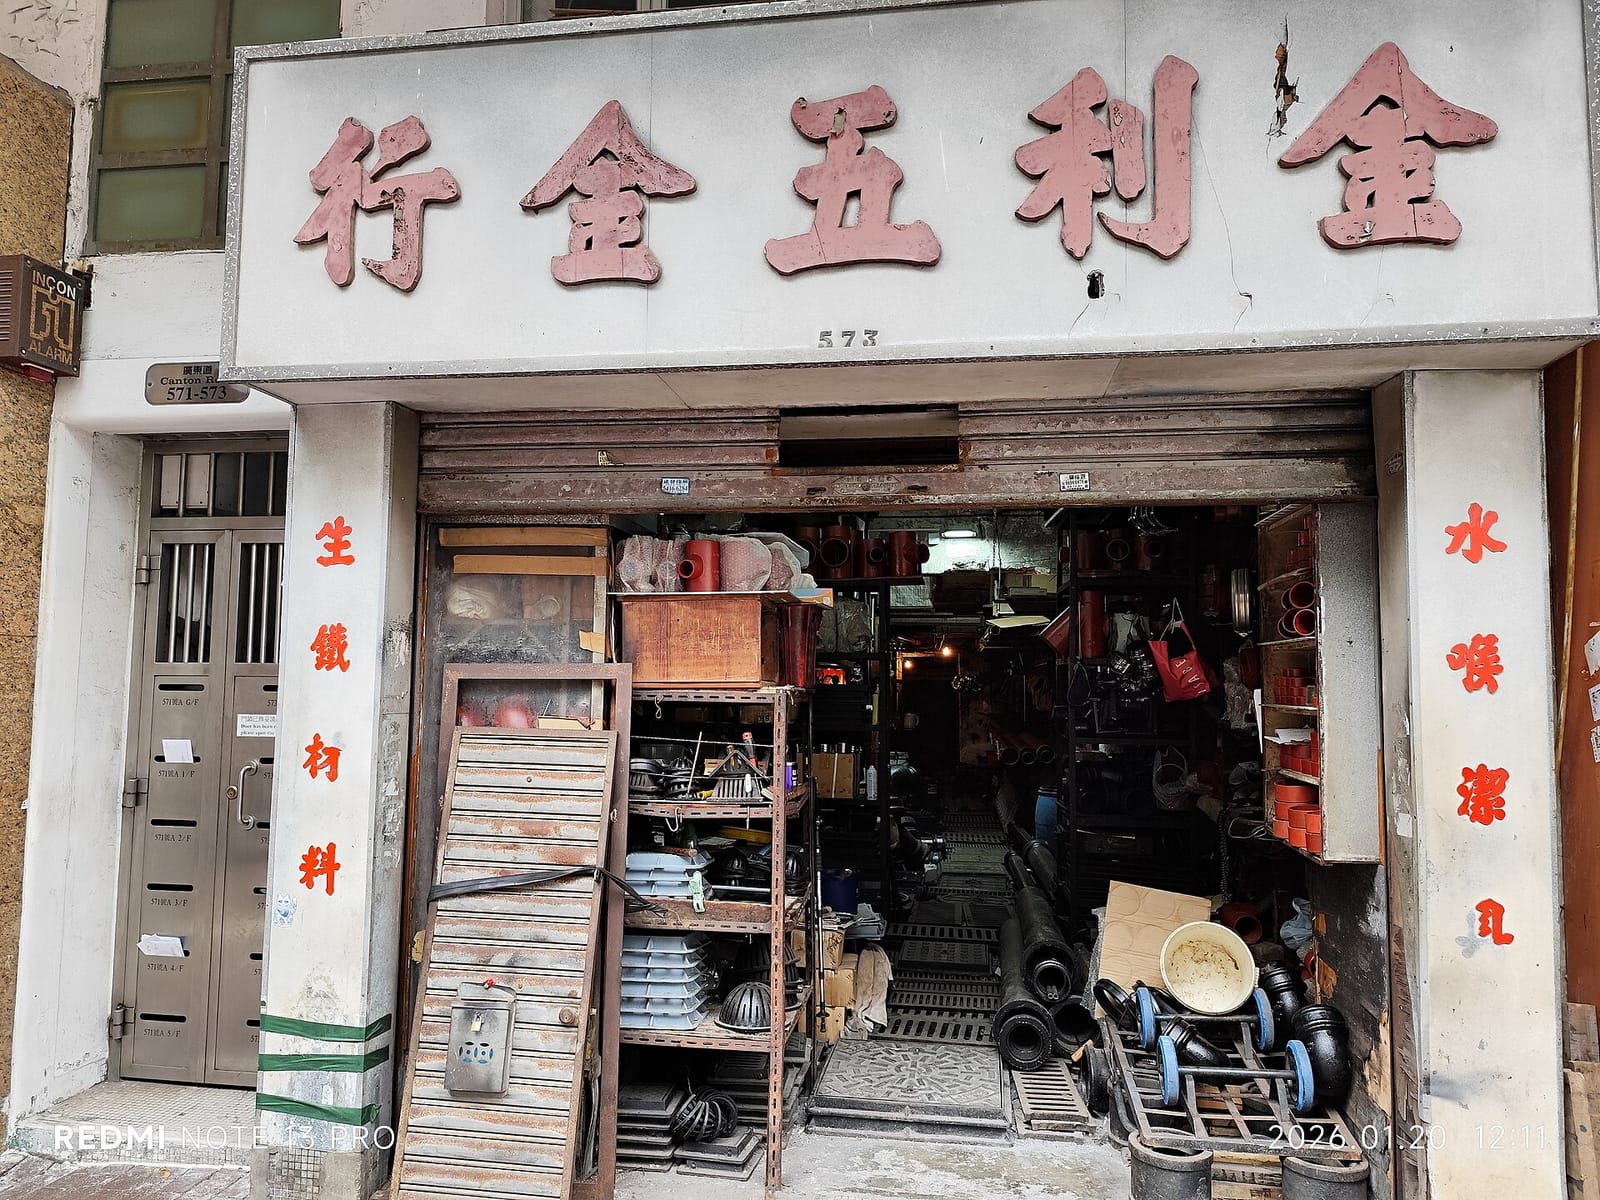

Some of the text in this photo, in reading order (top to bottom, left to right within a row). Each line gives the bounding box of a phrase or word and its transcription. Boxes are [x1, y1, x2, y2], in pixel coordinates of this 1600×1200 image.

[33, 270, 76, 299] INCON
[817, 328, 879, 348] 573
[29, 341, 73, 366] ALARM
[183, 365, 212, 375] 廣東道
[160, 376, 201, 385] Canton
[166, 386, 227, 401] 571-573
[300, 518, 354, 894] 生鐵材料
